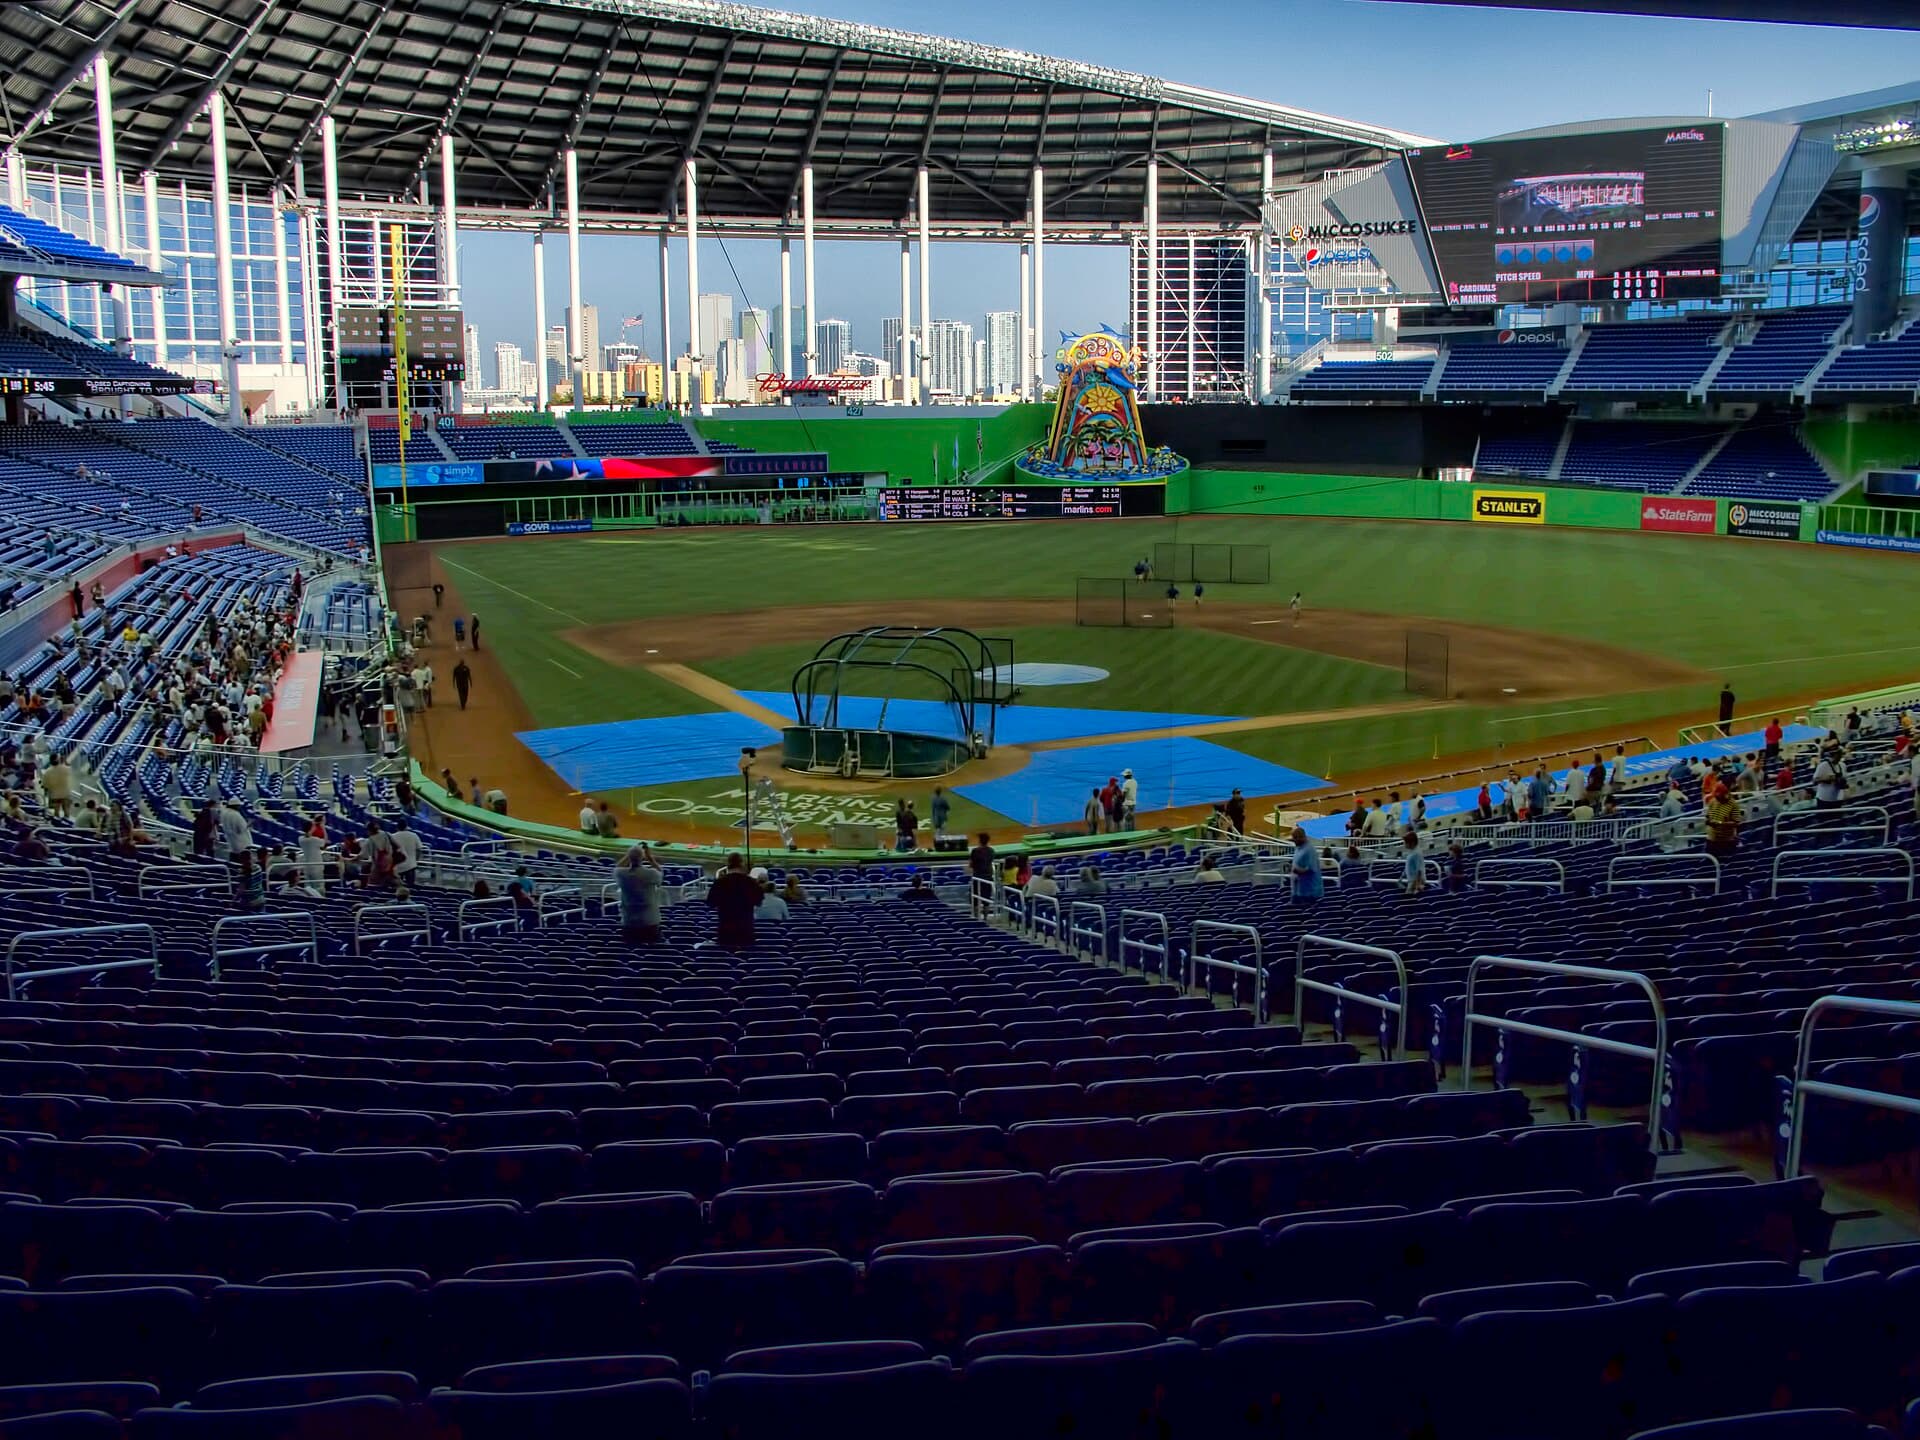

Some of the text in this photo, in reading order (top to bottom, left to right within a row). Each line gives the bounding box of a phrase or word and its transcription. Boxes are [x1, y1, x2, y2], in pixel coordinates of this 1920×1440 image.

[1665, 129, 1704, 143] MARLINS
[1308, 220, 1417, 238] MICCOSUKEE
[1323, 247, 1371, 264] pepsi
[1856, 232, 1872, 292] pepsi
[1495, 270, 1594, 282] PITCH SPEED MPH
[1459, 284, 1496, 293] CARDINALS
[1460, 294, 1497, 304] MARLINS
[1517, 332, 1554, 346] pepsi
[1376, 351, 1392, 360] 502
[34, 381, 55, 391] 5:45
[755, 372, 871, 392] Budweiser
[438, 417, 455, 427] 401
[444, 466, 475, 476] simply
[729, 459, 823, 473] CLEVELANDER
[1064, 505, 1113, 514] marlins.com
[1481, 501, 1536, 514] STANLEY
[1749, 510, 1799, 520] MICCOSUKEE
[1827, 534, 1866, 544] Preferred
[1867, 537, 1887, 546] Care
[706, 787, 895, 813] MARLINS
[813, 809, 932, 831] Nigt
